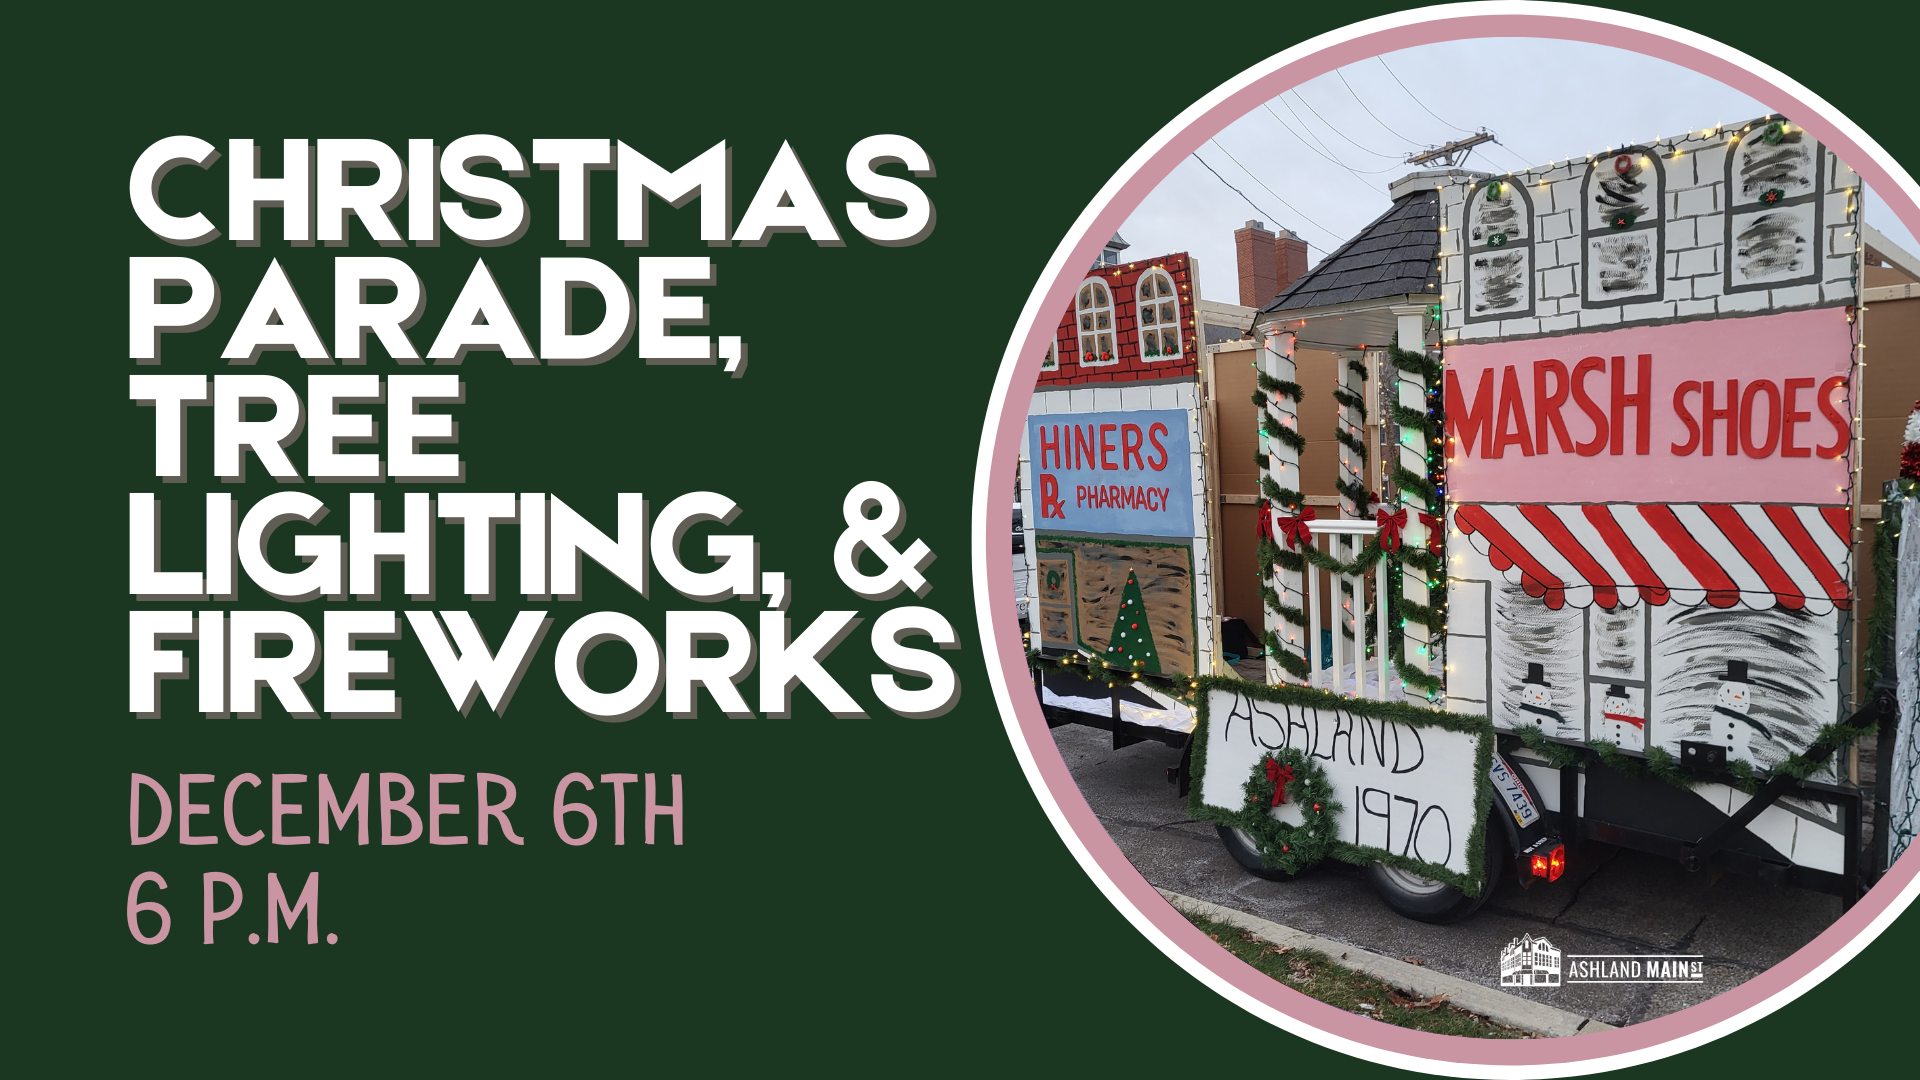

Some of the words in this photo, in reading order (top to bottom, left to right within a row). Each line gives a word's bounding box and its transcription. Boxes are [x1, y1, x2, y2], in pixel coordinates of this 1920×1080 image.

[1445, 354, 1652, 460] MARSH
[1670, 376, 1851, 460] SHOES
[1039, 422, 1169, 472] HINERS
[1076, 484, 1170, 513] PHARMACY
[1225, 692, 1425, 774] ASHLAND
[1355, 785, 1452, 867] 1970
[1506, 782, 1533, 819] 7439
